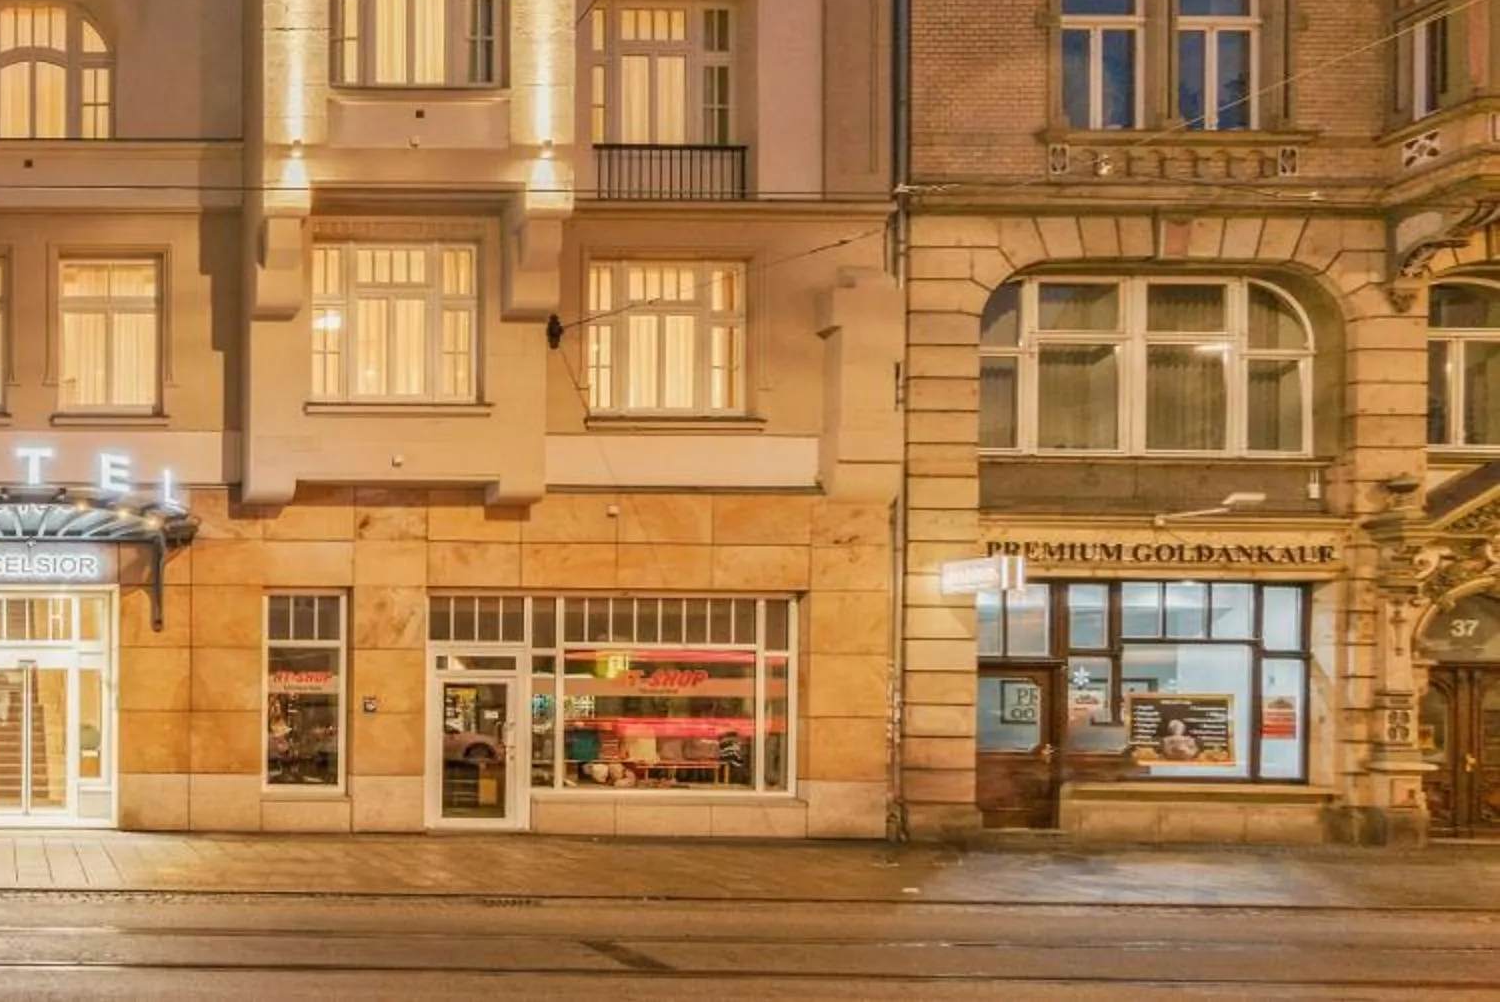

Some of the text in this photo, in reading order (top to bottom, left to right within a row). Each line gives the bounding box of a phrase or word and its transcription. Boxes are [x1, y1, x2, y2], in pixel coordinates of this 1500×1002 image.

[986, 541, 1334, 564] PREMIUM GOLDANKAUF
[1450, 619, 1479, 637] 37
